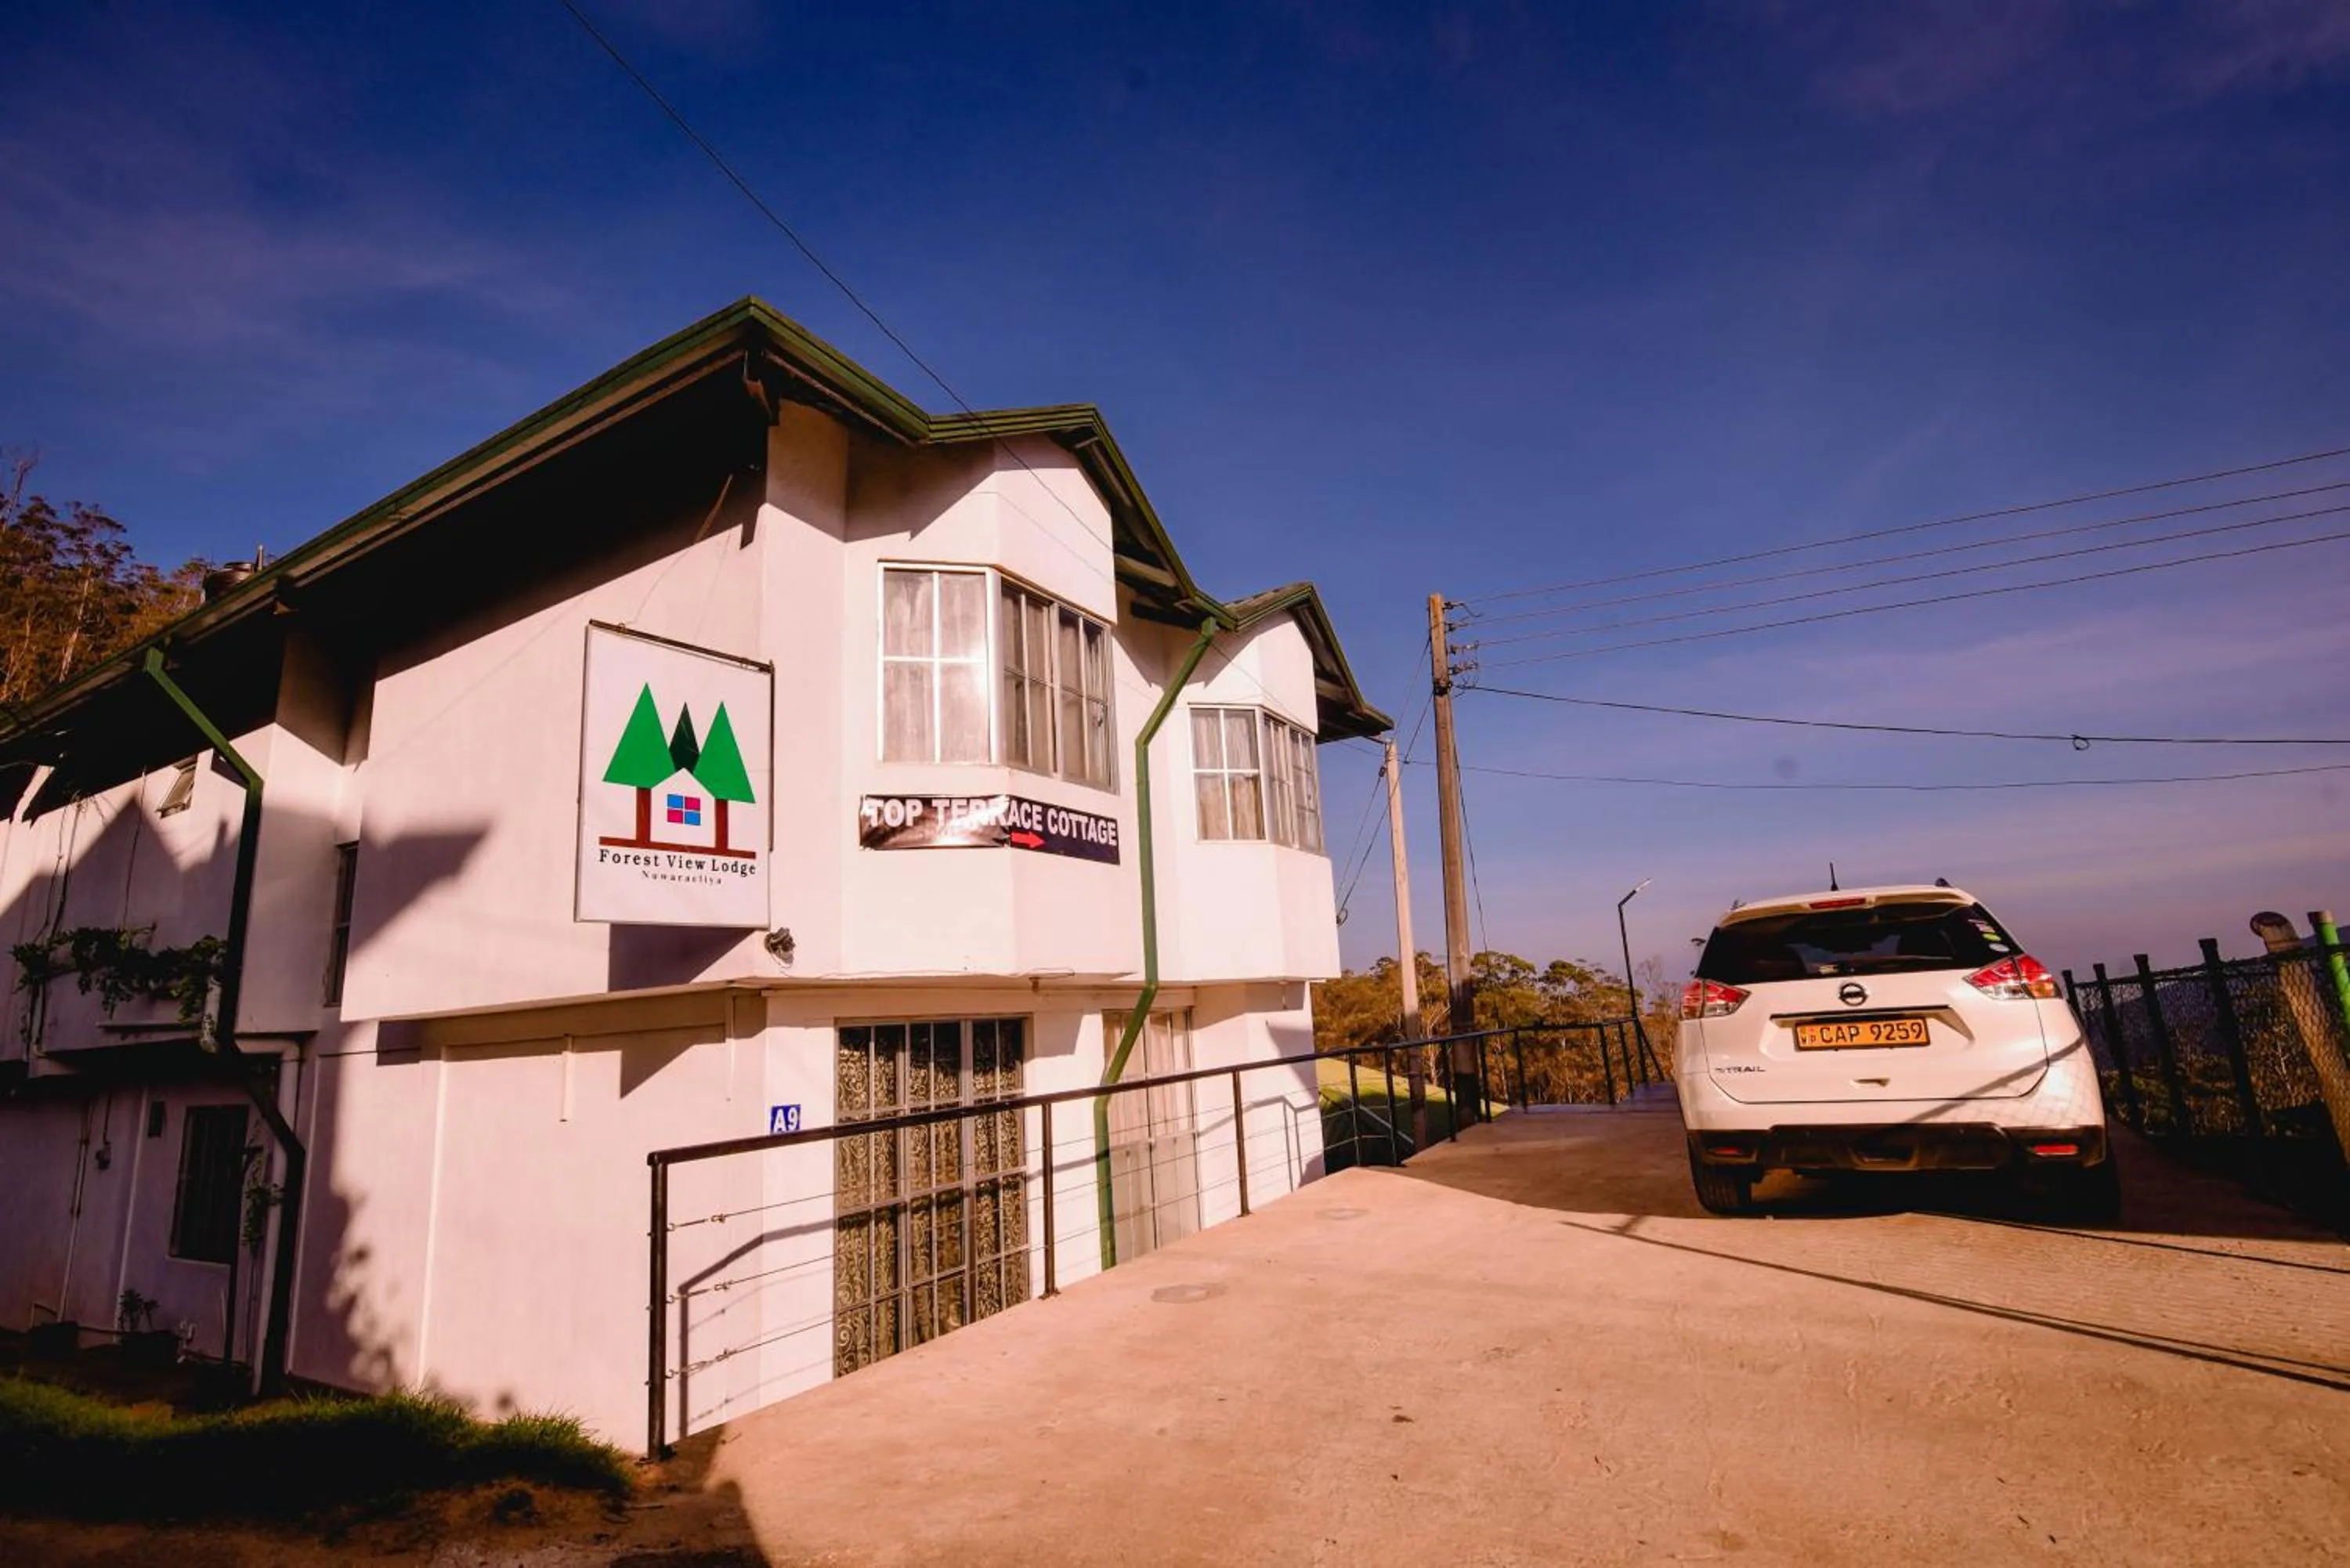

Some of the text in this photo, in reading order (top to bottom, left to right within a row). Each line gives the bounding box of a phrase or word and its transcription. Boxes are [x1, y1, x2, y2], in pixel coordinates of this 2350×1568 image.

[864, 798, 1117, 847] TOP TERRACE COTTAGE
[598, 848, 757, 877] Forest View Lodge
[1820, 1025, 1860, 1043] CAP
[1870, 1021, 1923, 1042] 9259
[773, 1107, 798, 1133] A9
